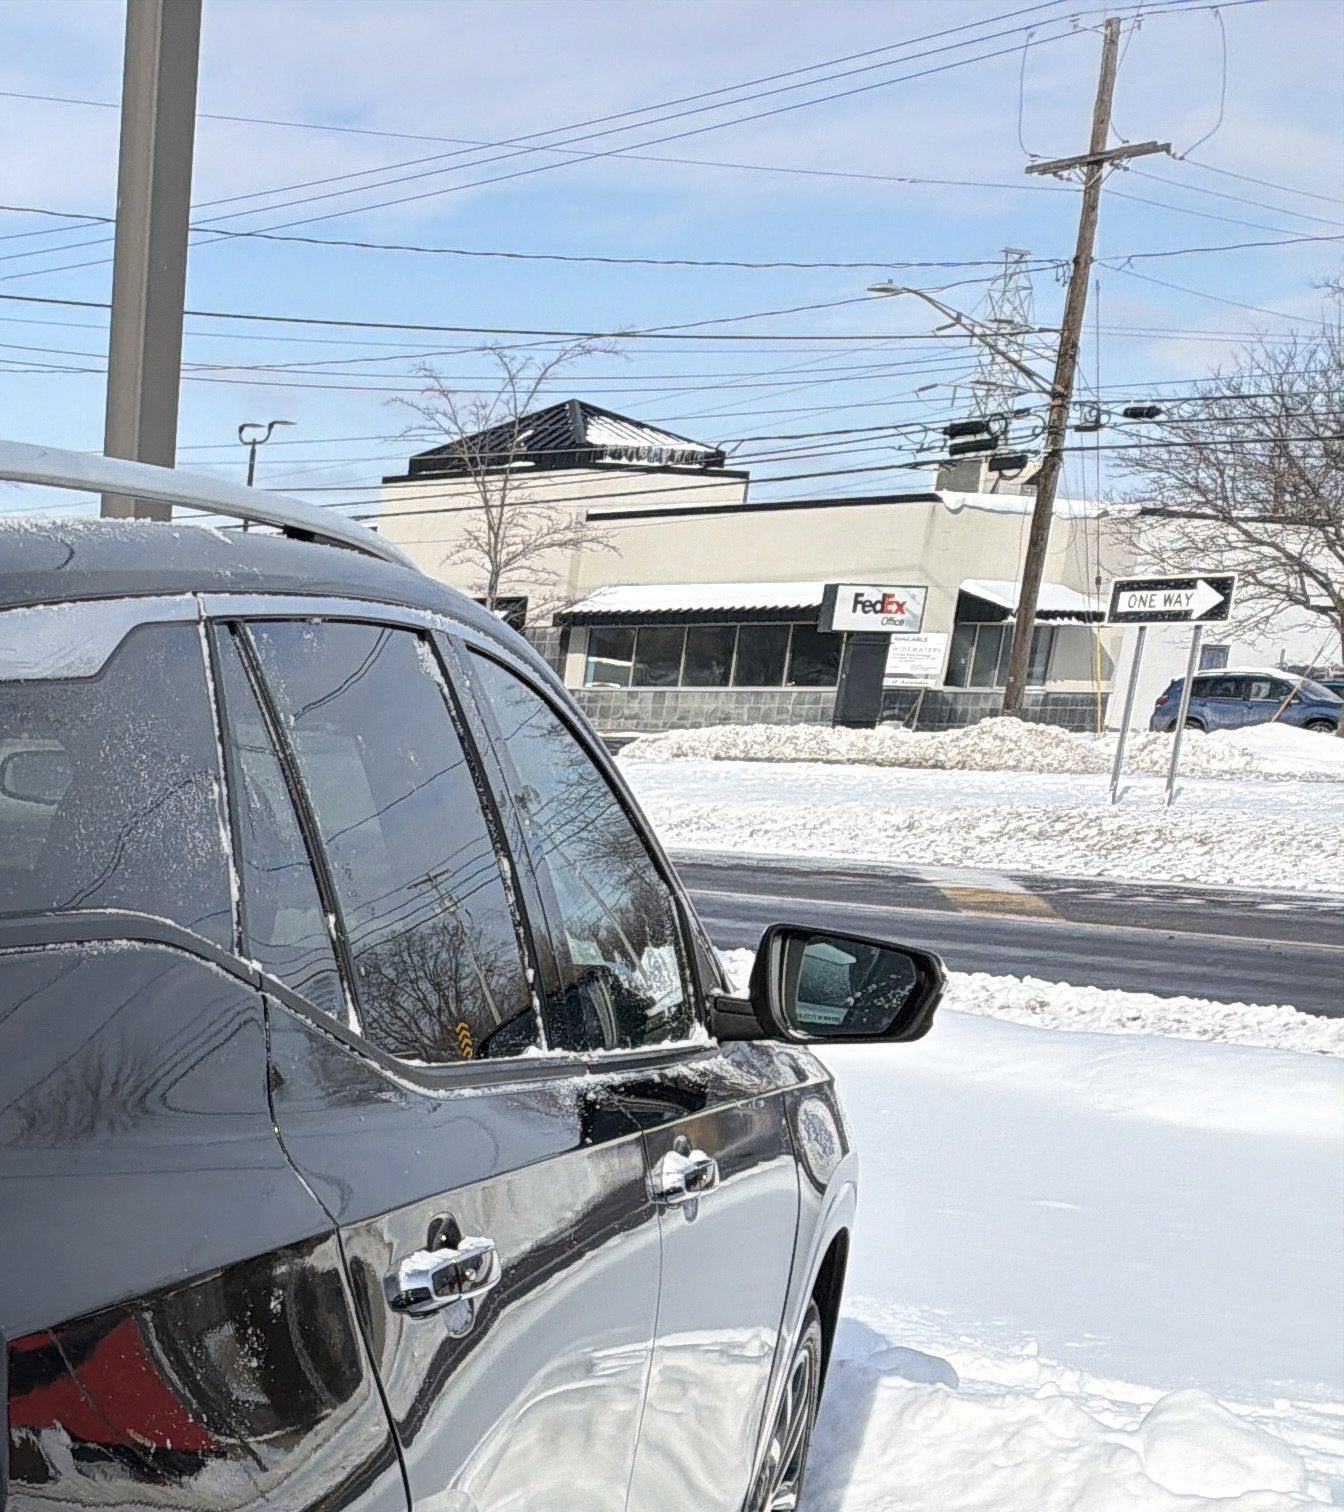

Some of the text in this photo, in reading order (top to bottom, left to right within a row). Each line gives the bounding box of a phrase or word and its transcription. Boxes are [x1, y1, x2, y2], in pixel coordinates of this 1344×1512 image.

[852, 593, 907, 614] FedEx
[1127, 592, 1194, 608] ONE WAY
[880, 616, 905, 626] Office
